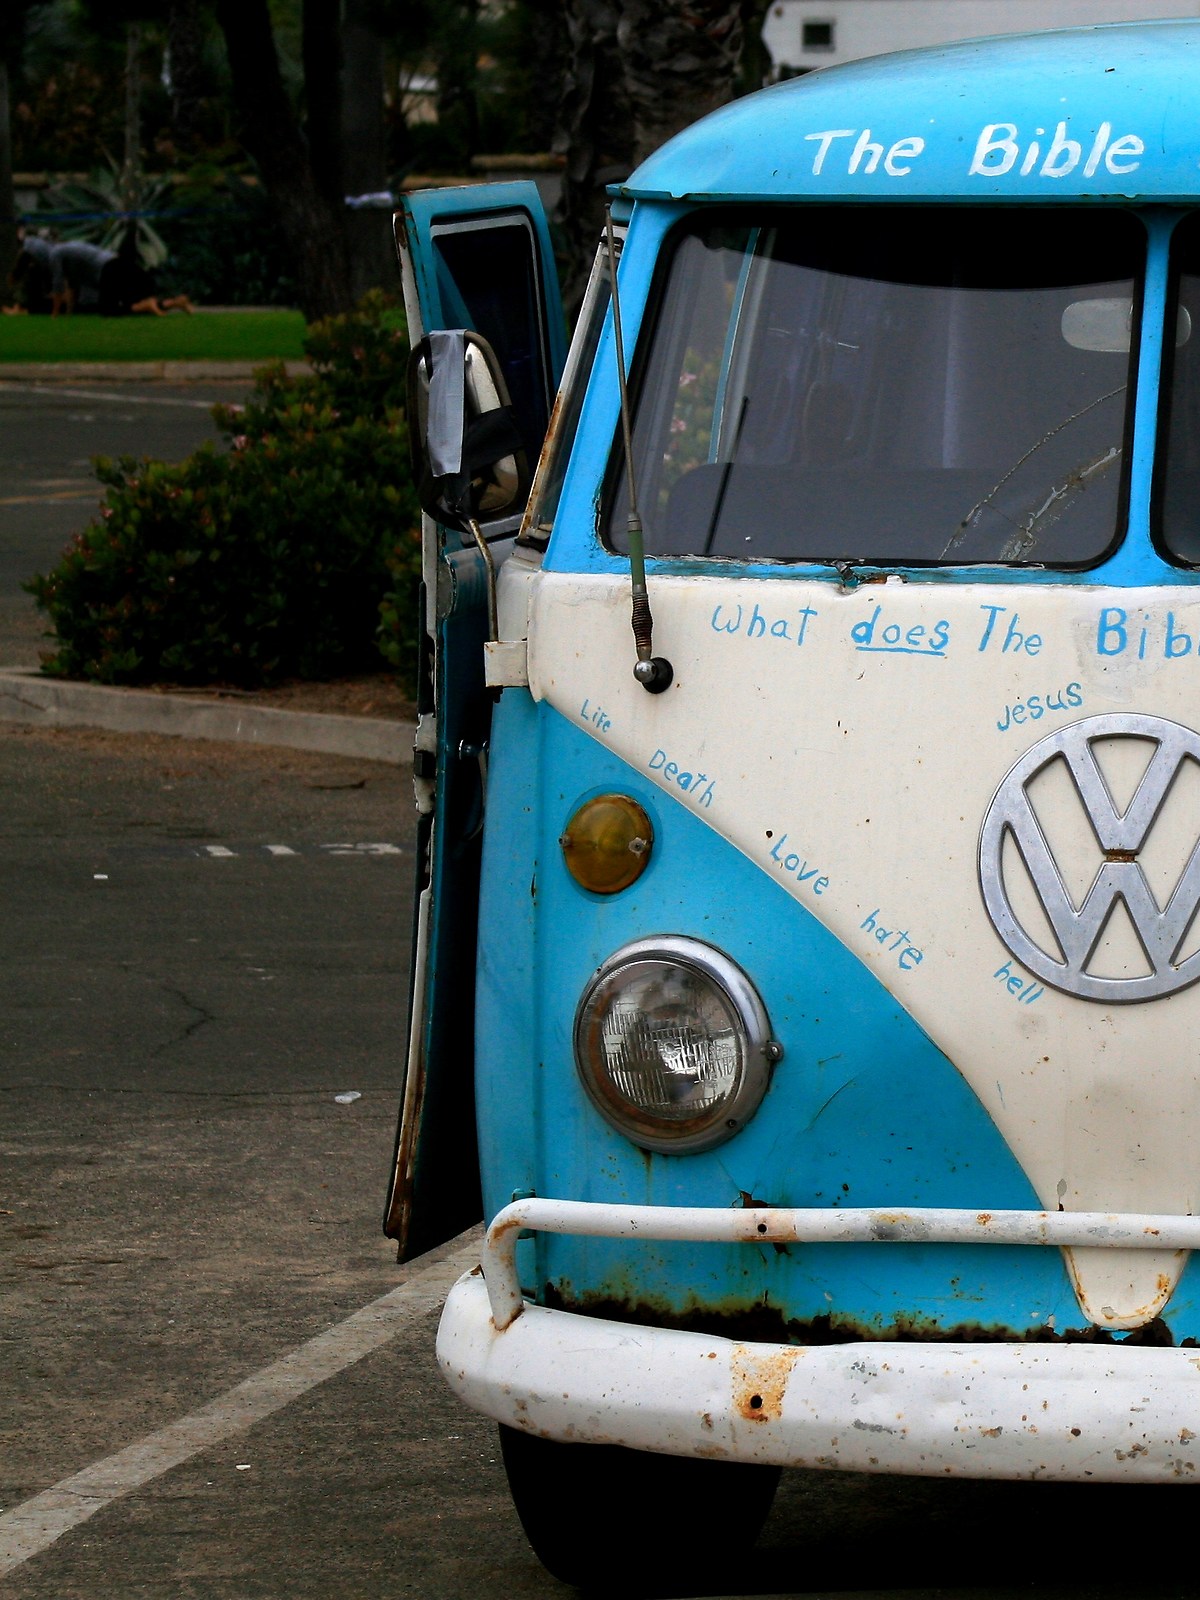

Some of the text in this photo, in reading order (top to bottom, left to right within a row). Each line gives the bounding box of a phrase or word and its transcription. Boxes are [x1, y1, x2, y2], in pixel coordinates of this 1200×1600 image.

[805, 128, 925, 176] The
[968, 121, 1145, 178] Bible
[711, 604, 818, 646] What
[850, 605, 951, 653] does
[978, 604, 1043, 656] The
[648, 748, 716, 808] Death
[768, 833, 831, 896] Love
[859, 908, 924, 971] hate
[994, 960, 1046, 1006] hell
